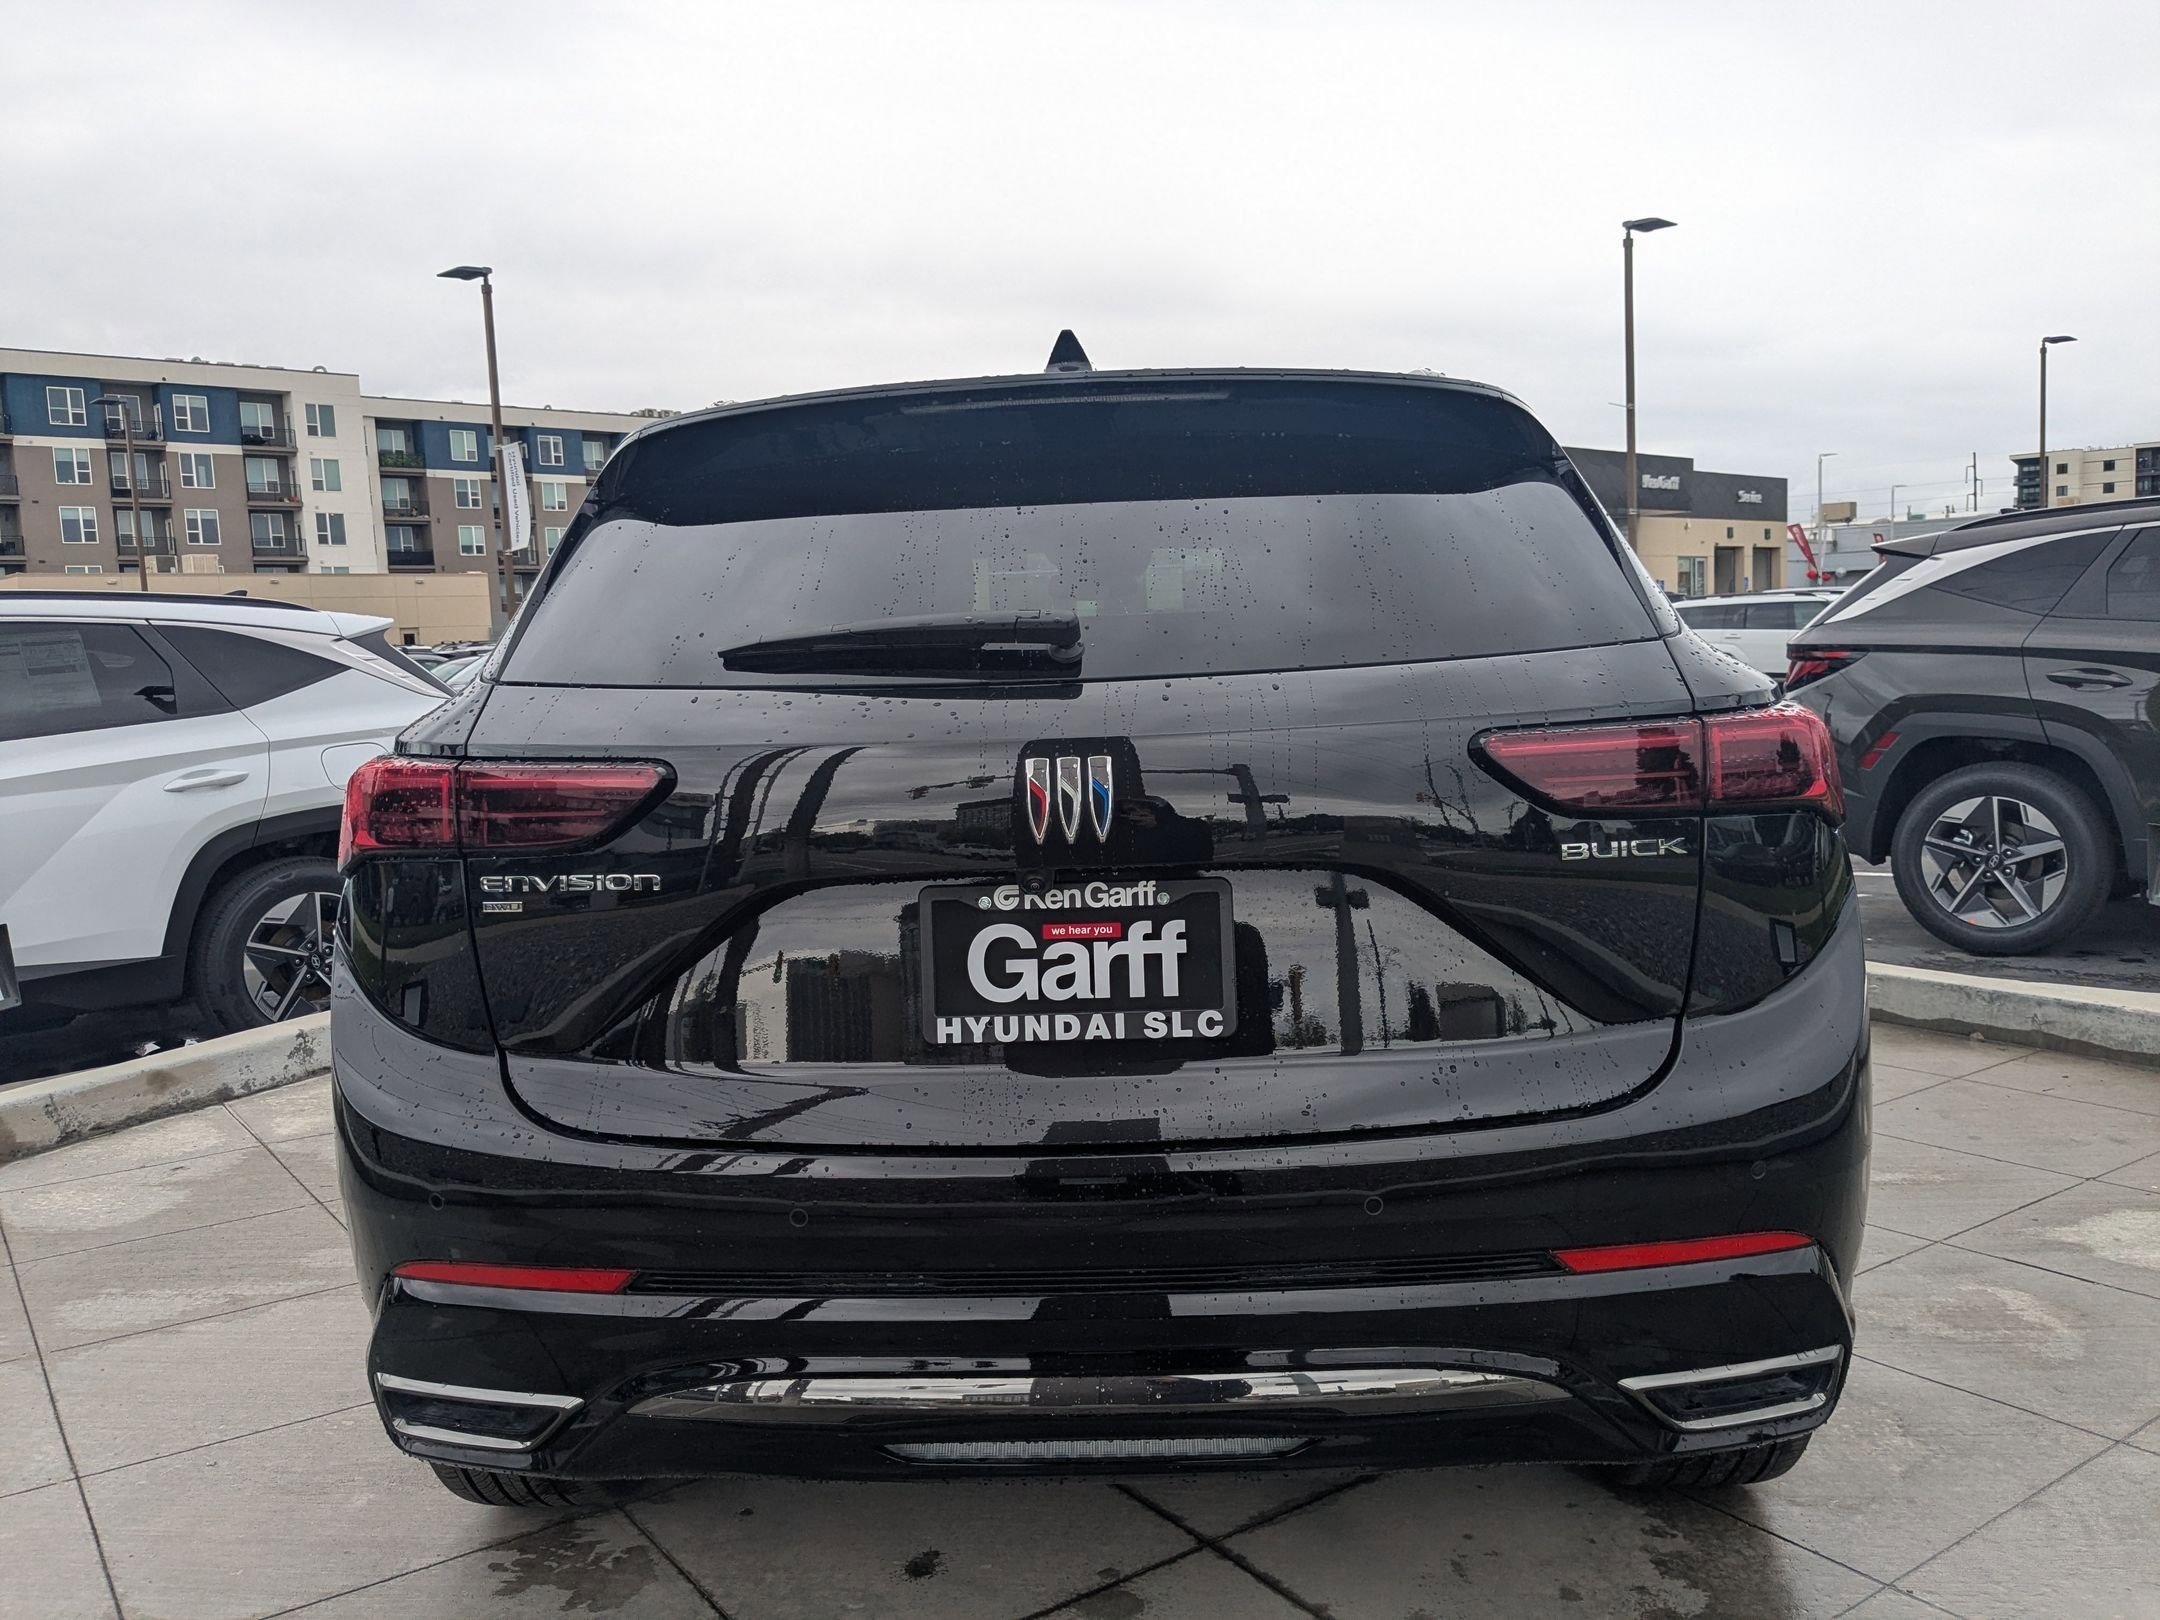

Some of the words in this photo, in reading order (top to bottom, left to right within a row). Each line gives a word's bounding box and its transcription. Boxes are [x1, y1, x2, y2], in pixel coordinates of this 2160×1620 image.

[1561, 837, 1688, 861] BUICK
[479, 874, 661, 893] ENVISION
[1024, 887, 1082, 910] Ken
[1085, 880, 1157, 908] Garff
[1068, 925, 1091, 935] hear
[1094, 927, 1113, 936] you
[967, 919, 1187, 1004] Garff
[937, 1013, 1125, 1044] HYUNDAI
[1144, 1010, 1224, 1038] SLC
